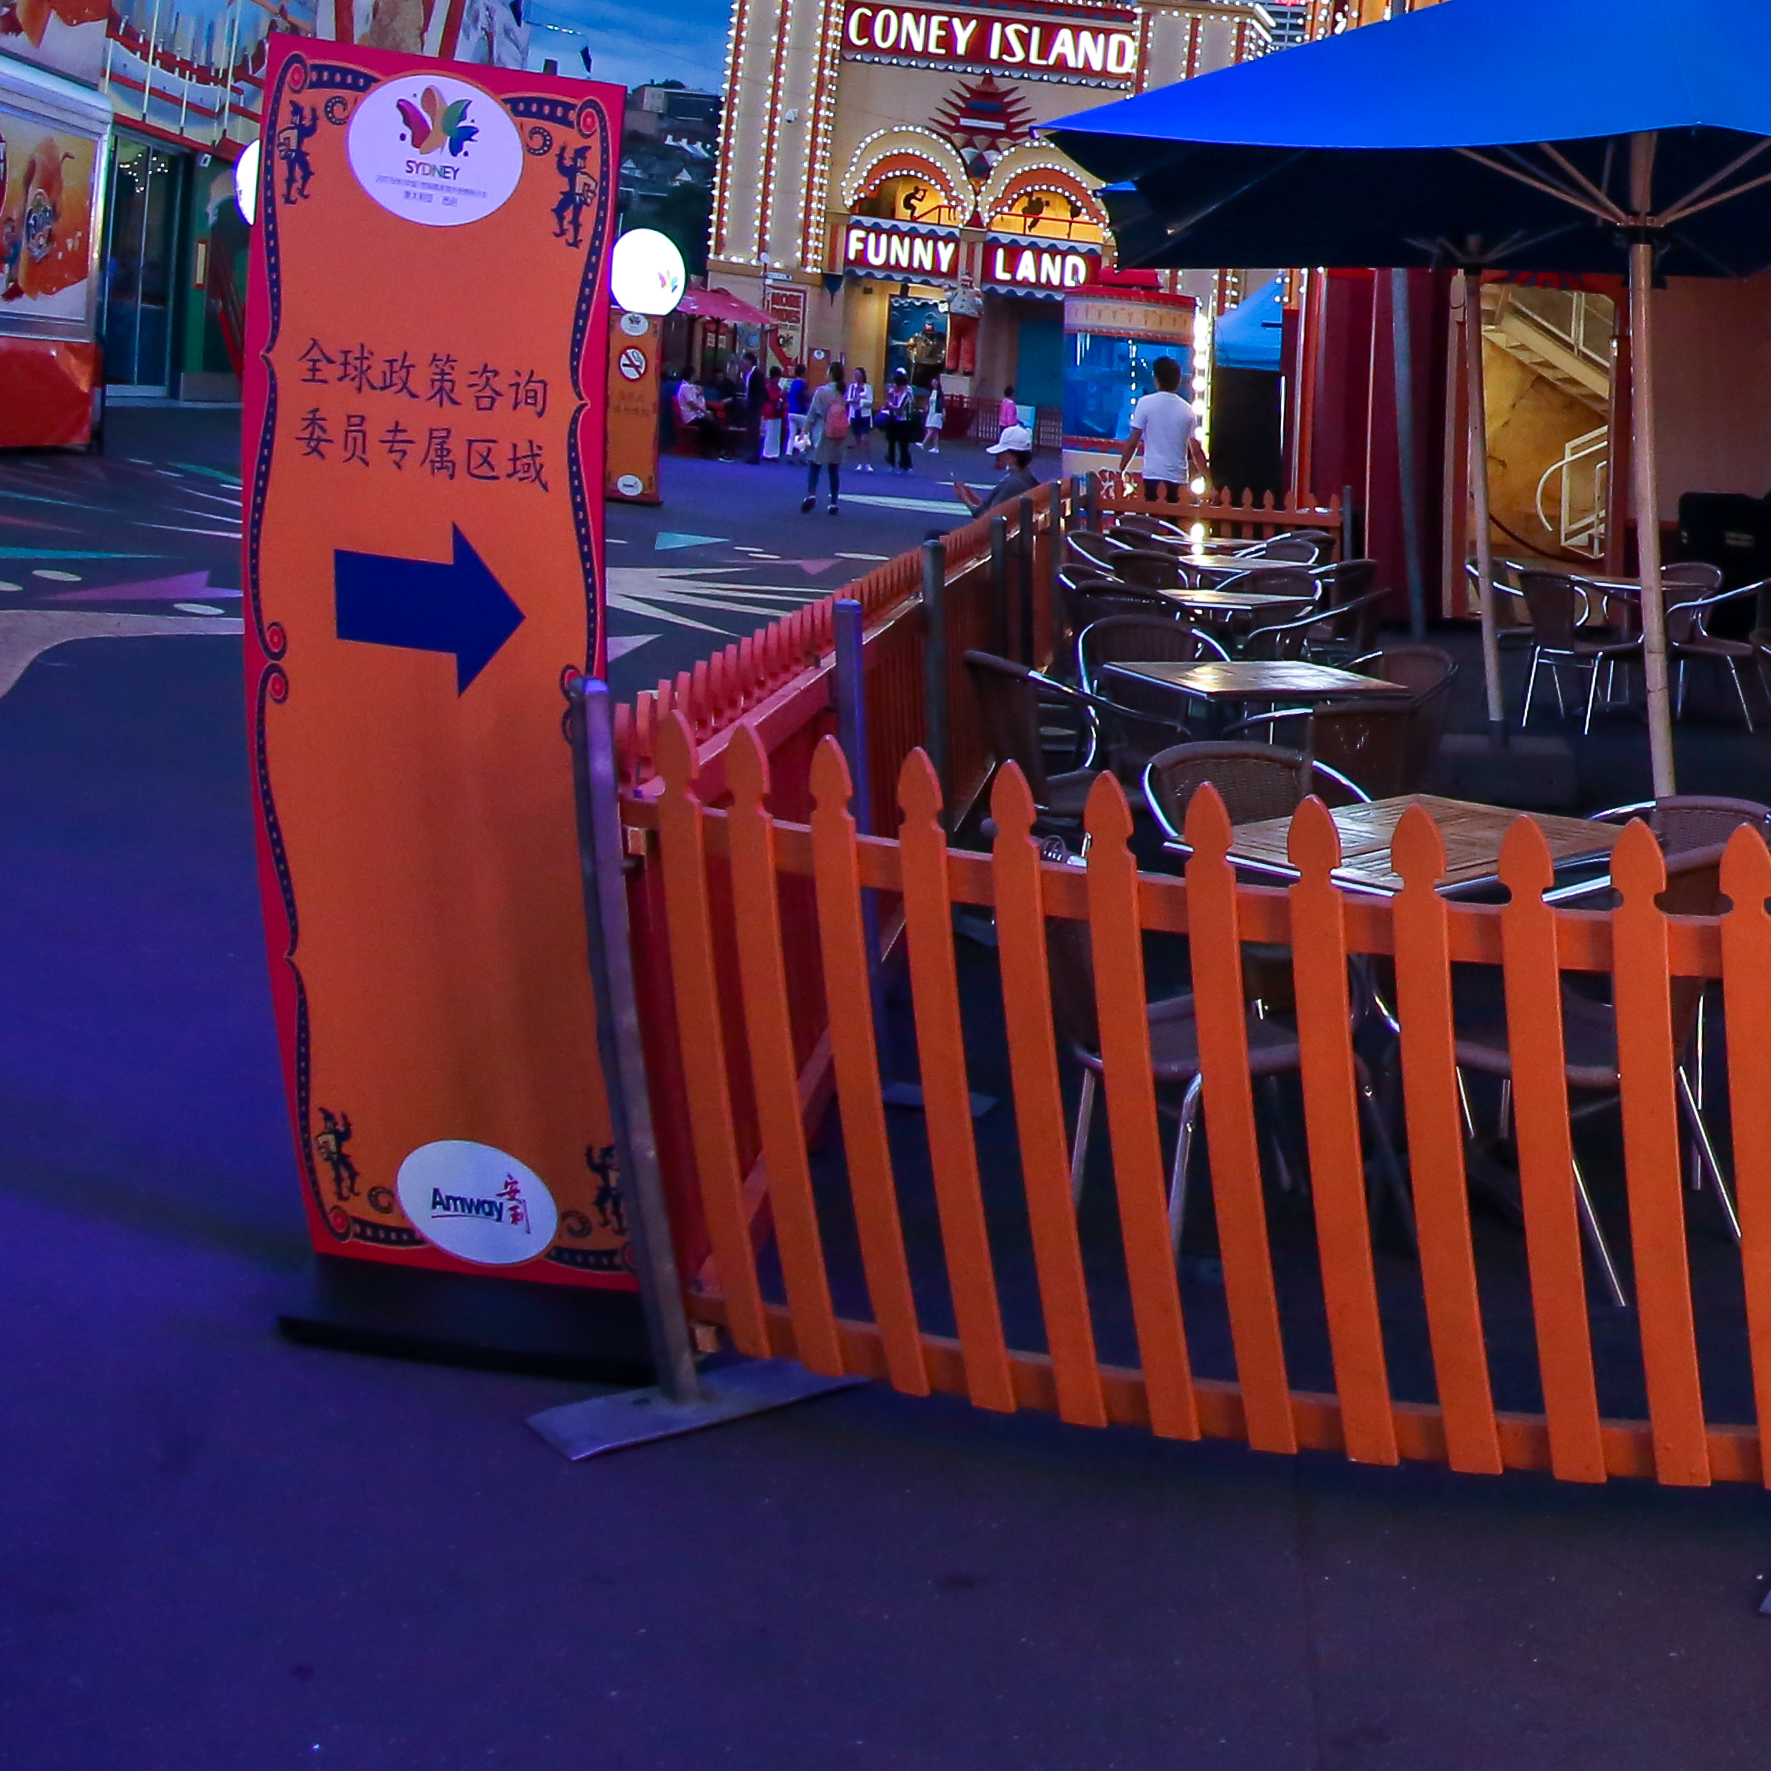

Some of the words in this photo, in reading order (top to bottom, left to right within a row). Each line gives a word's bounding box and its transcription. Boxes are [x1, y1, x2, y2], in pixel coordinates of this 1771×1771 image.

[847, 6, 977, 56] CONEY
[988, 23, 1136, 75] ISLAND
[405, 159, 460, 181] SYDNEY
[846, 229, 956, 275] FUNNY
[994, 247, 1087, 287] LAND
[296, 337, 549, 419] 全球政策咨询
[294, 406, 550, 492] 委员专属区域
[430, 1187, 504, 1222] Amway
